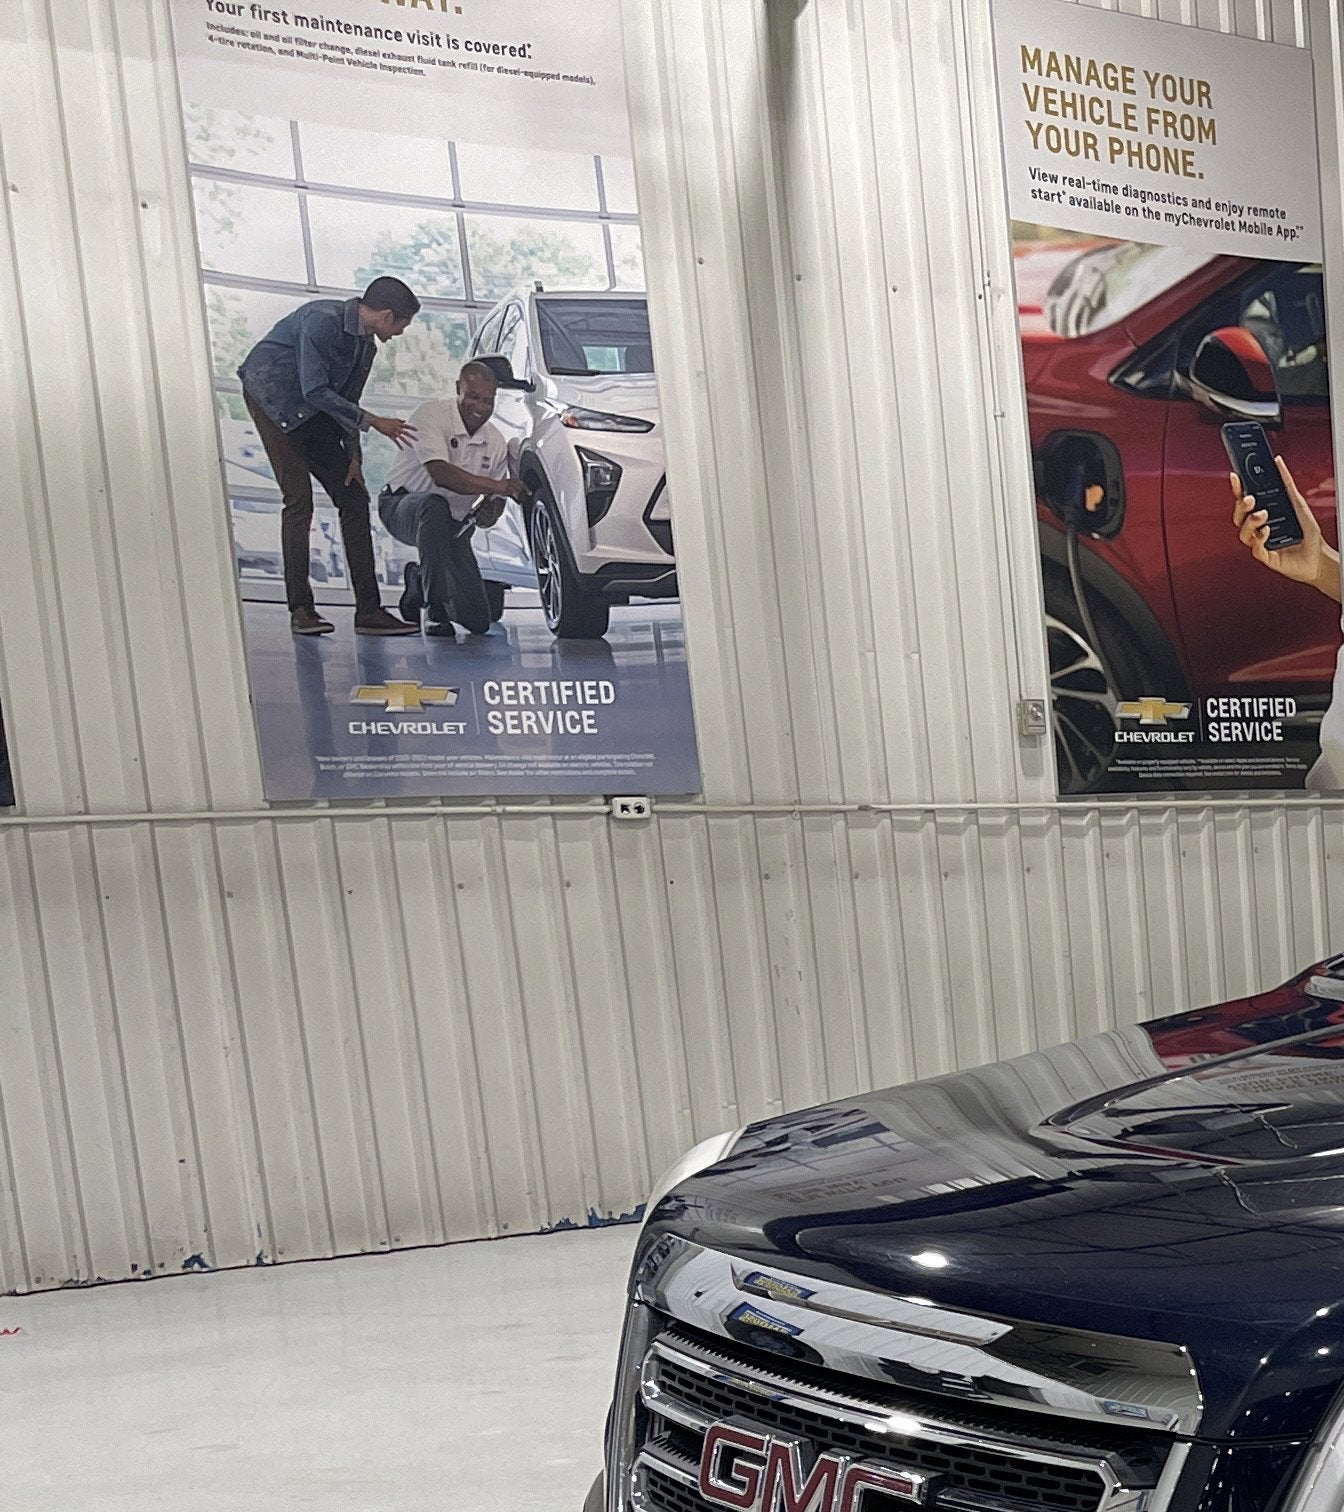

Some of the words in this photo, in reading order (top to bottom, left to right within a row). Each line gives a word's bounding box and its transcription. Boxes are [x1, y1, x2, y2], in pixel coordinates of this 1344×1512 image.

[206, 0, 244, 17] Your
[250, 3, 289, 25] first
[294, 14, 403, 43] maintenance
[407, 29, 442, 48] visit
[446, 34, 459, 50] is
[264, 31, 280, 42] and
[1020, 44, 1137, 96] MANAGE
[1143, 69, 1214, 110] YOUR
[1022, 82, 1139, 133] VEHICLE
[1146, 106, 1217, 146] FROM
[1025, 119, 1101, 162] YOUR
[1108, 136, 1205, 180] PHONE.
[1028, 166, 1059, 184] View
[1062, 176, 1119, 195] real-time
[1122, 184, 1188, 207] diagnostics
[1191, 198, 1212, 211] and
[1214, 200, 1245, 217] enjoy
[1247, 206, 1287, 220] remote
[1069, 196, 1121, 214] available
[1124, 205, 1139, 217] on
[1142, 206, 1161, 220] the
[1164, 211, 1236, 232] myChevrolet
[1238, 220, 1273, 236] Mobile
[483, 681, 616, 706] CERTIFIED
[1206, 697, 1297, 718] CERTIFIED
[348, 721, 467, 735] CHEVROLET
[487, 709, 598, 735] SERVICE
[1114, 731, 1195, 743] CHEVROLET
[1208, 721, 1283, 742] SERVICE
